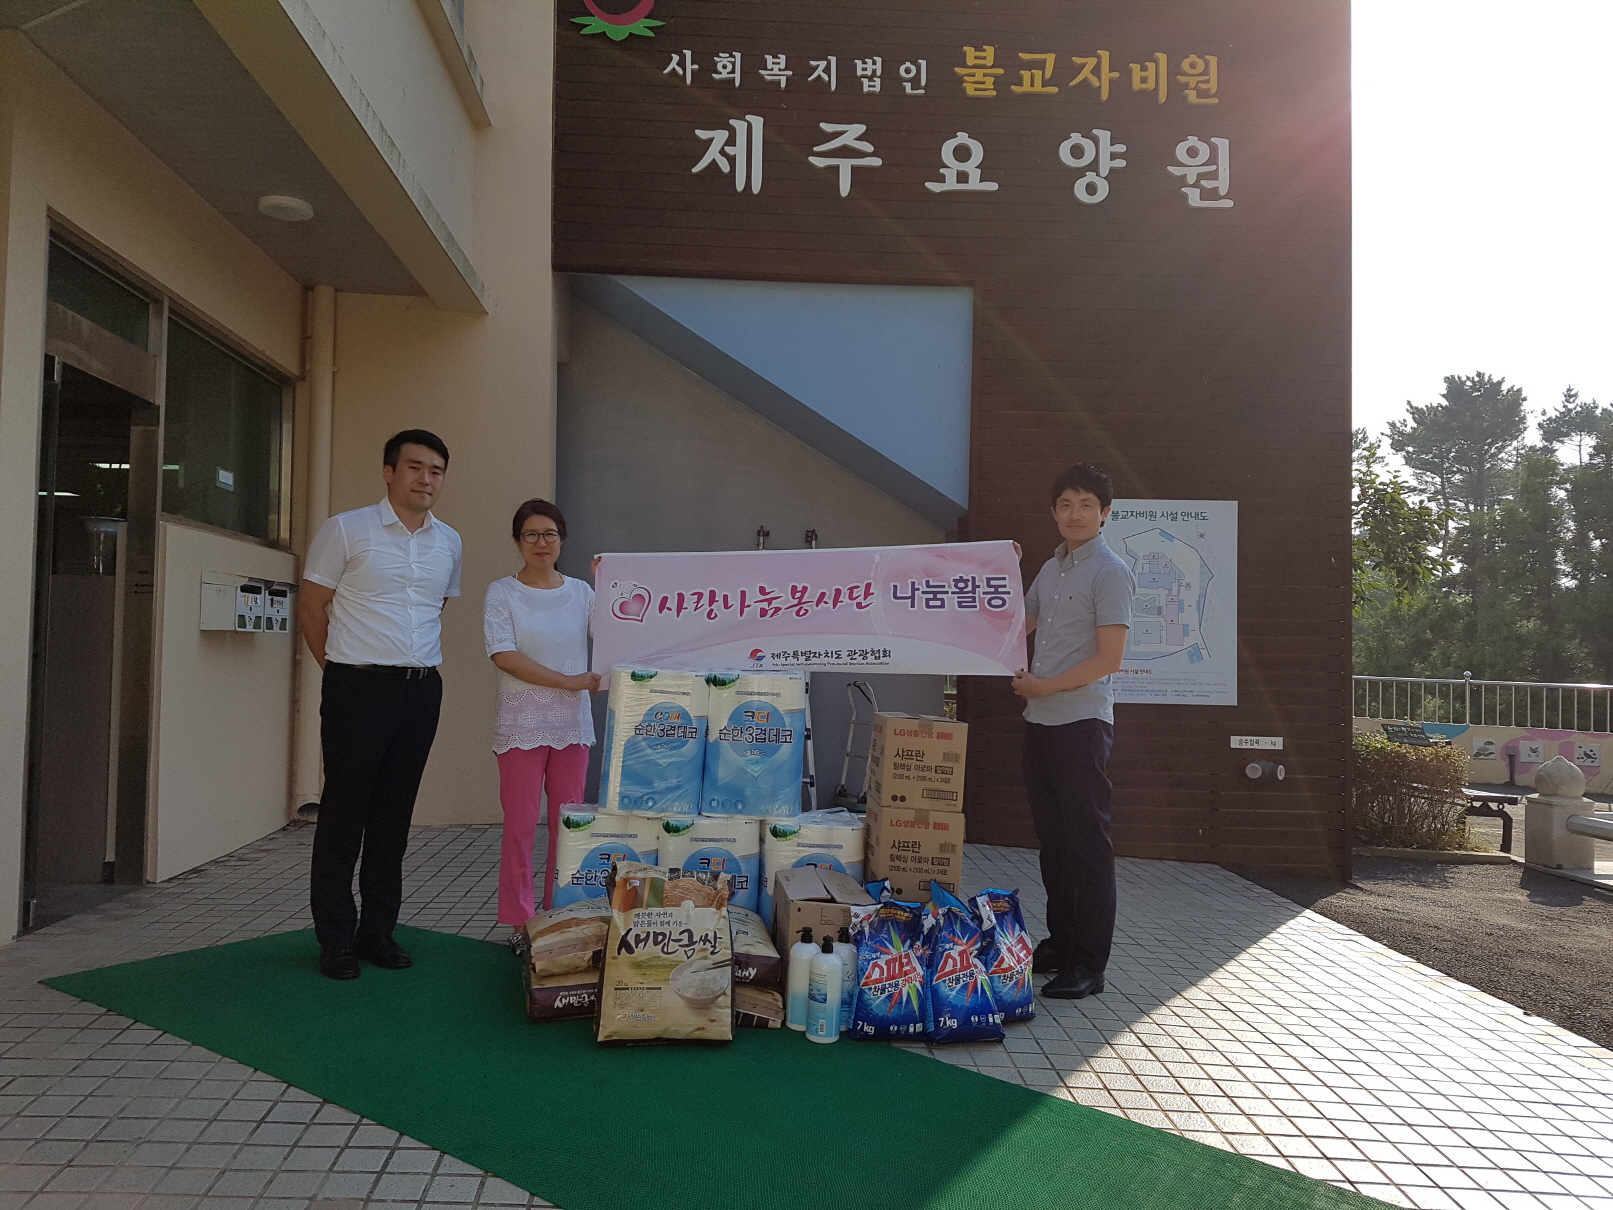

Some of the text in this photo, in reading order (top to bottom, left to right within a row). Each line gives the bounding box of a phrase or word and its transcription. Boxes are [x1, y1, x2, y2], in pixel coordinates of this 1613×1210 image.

[662, 45, 1223, 104] 사회복지법인 불교자비원
[691, 114, 1235, 209] 제주요양원
[1110, 510, 1209, 521] 불교자비원 시설 안내도
[657, 574, 1012, 621] 사랑나눔봉사단 나눔활동
[770, 648, 892, 662] 제주특별자치도 관광협회
[655, 711, 682, 722] CODI
[743, 710, 771, 724] 코디
[894, 748, 926, 762] 샤프란
[893, 762, 912, 772] 릴렉싱
[914, 764, 933, 773] 아로마
[890, 839, 922, 853] 샤프란
[598, 852, 627, 866] 코디
[698, 857, 726, 870] 코디
[889, 853, 909, 864] 릴렉싱
[910, 855, 929, 865] 아로마
[634, 911, 674, 919] 깨끗한 자연과
[617, 927, 724, 960] 새만금쌀
[860, 952, 918, 988] 스파크
[934, 947, 977, 983] 스파
[946, 969, 976, 989] 찬물전용
[871, 980, 901, 997] 찬물전용
